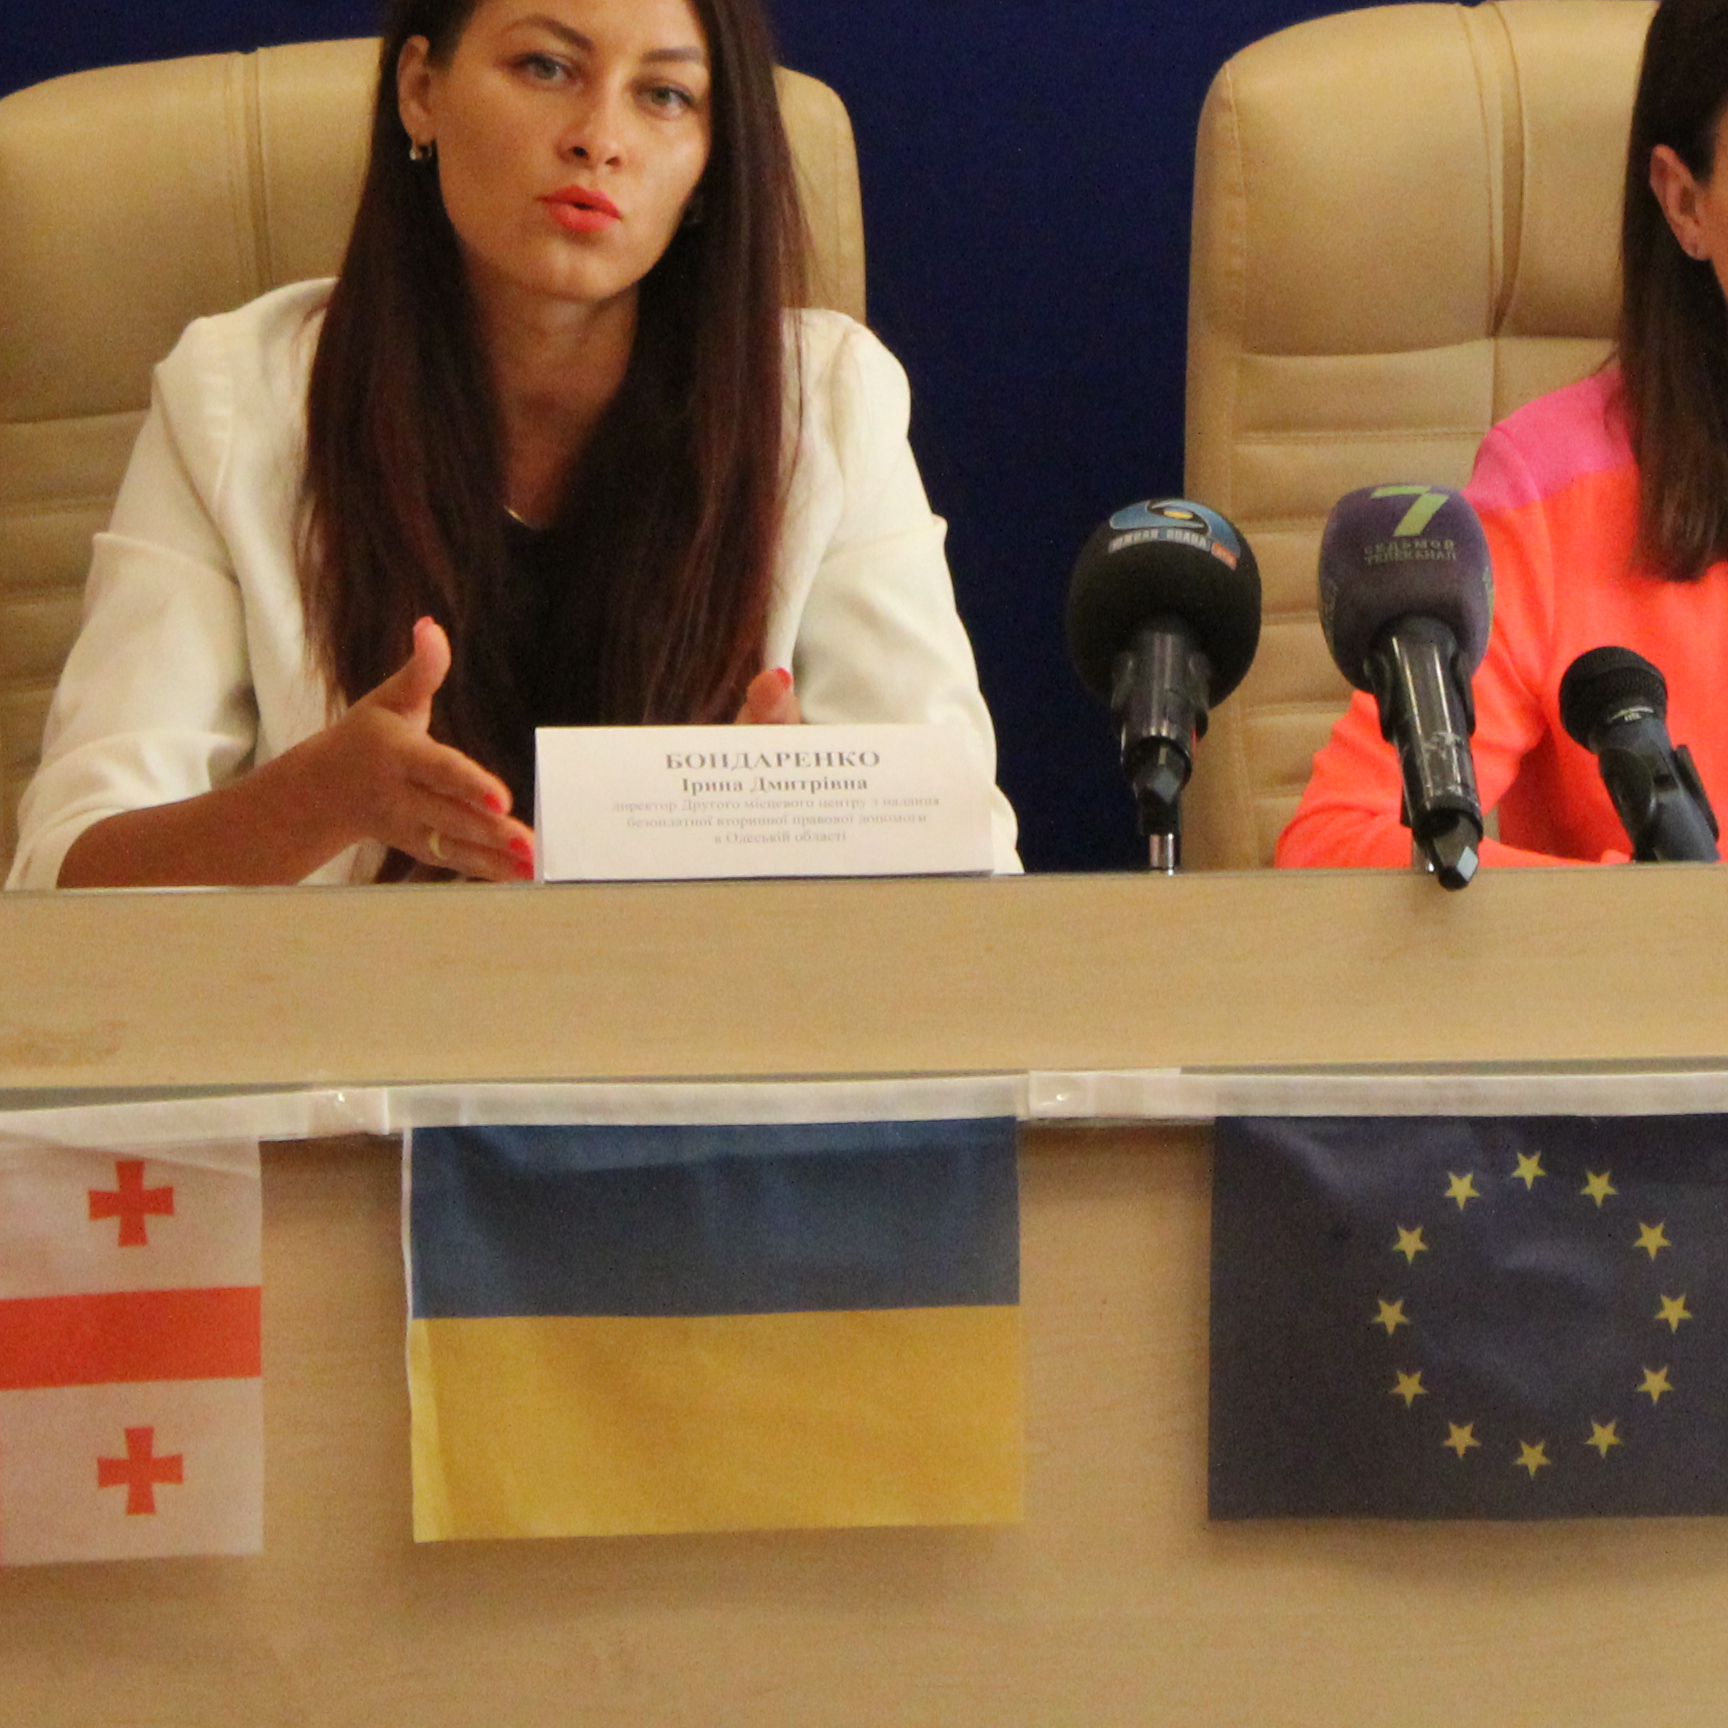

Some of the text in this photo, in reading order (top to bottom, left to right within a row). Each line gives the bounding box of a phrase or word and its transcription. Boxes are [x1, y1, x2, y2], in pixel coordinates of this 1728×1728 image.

[1370, 484, 1450, 537] 7
[665, 751, 880, 771] БОНДАРЕНКО
[681, 775, 868, 797] Ірина Дмитрівна
